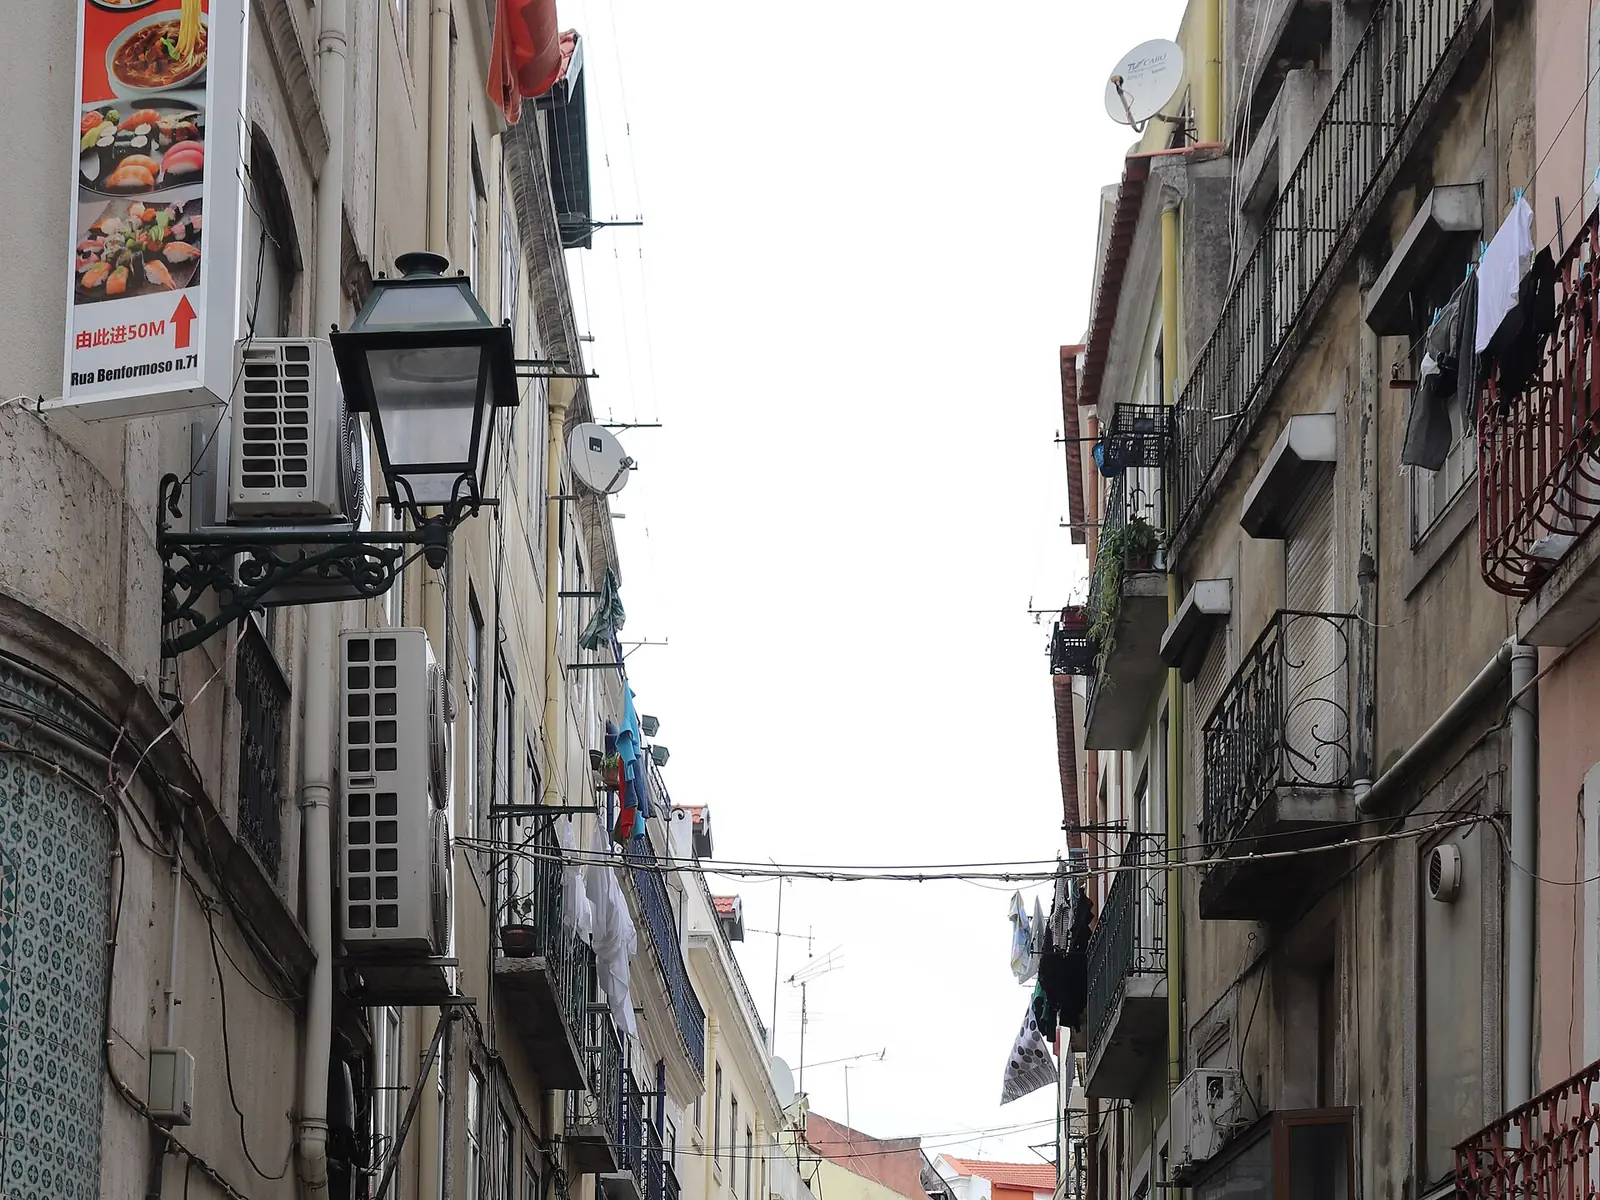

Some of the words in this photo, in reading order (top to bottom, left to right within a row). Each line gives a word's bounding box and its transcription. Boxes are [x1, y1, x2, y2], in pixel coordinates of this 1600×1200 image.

[76, 320, 165, 349] 由此进50M
[71, 372, 95, 386] Rua
[97, 360, 172, 383] Benformoso
[175, 354, 198, 371] n.71
